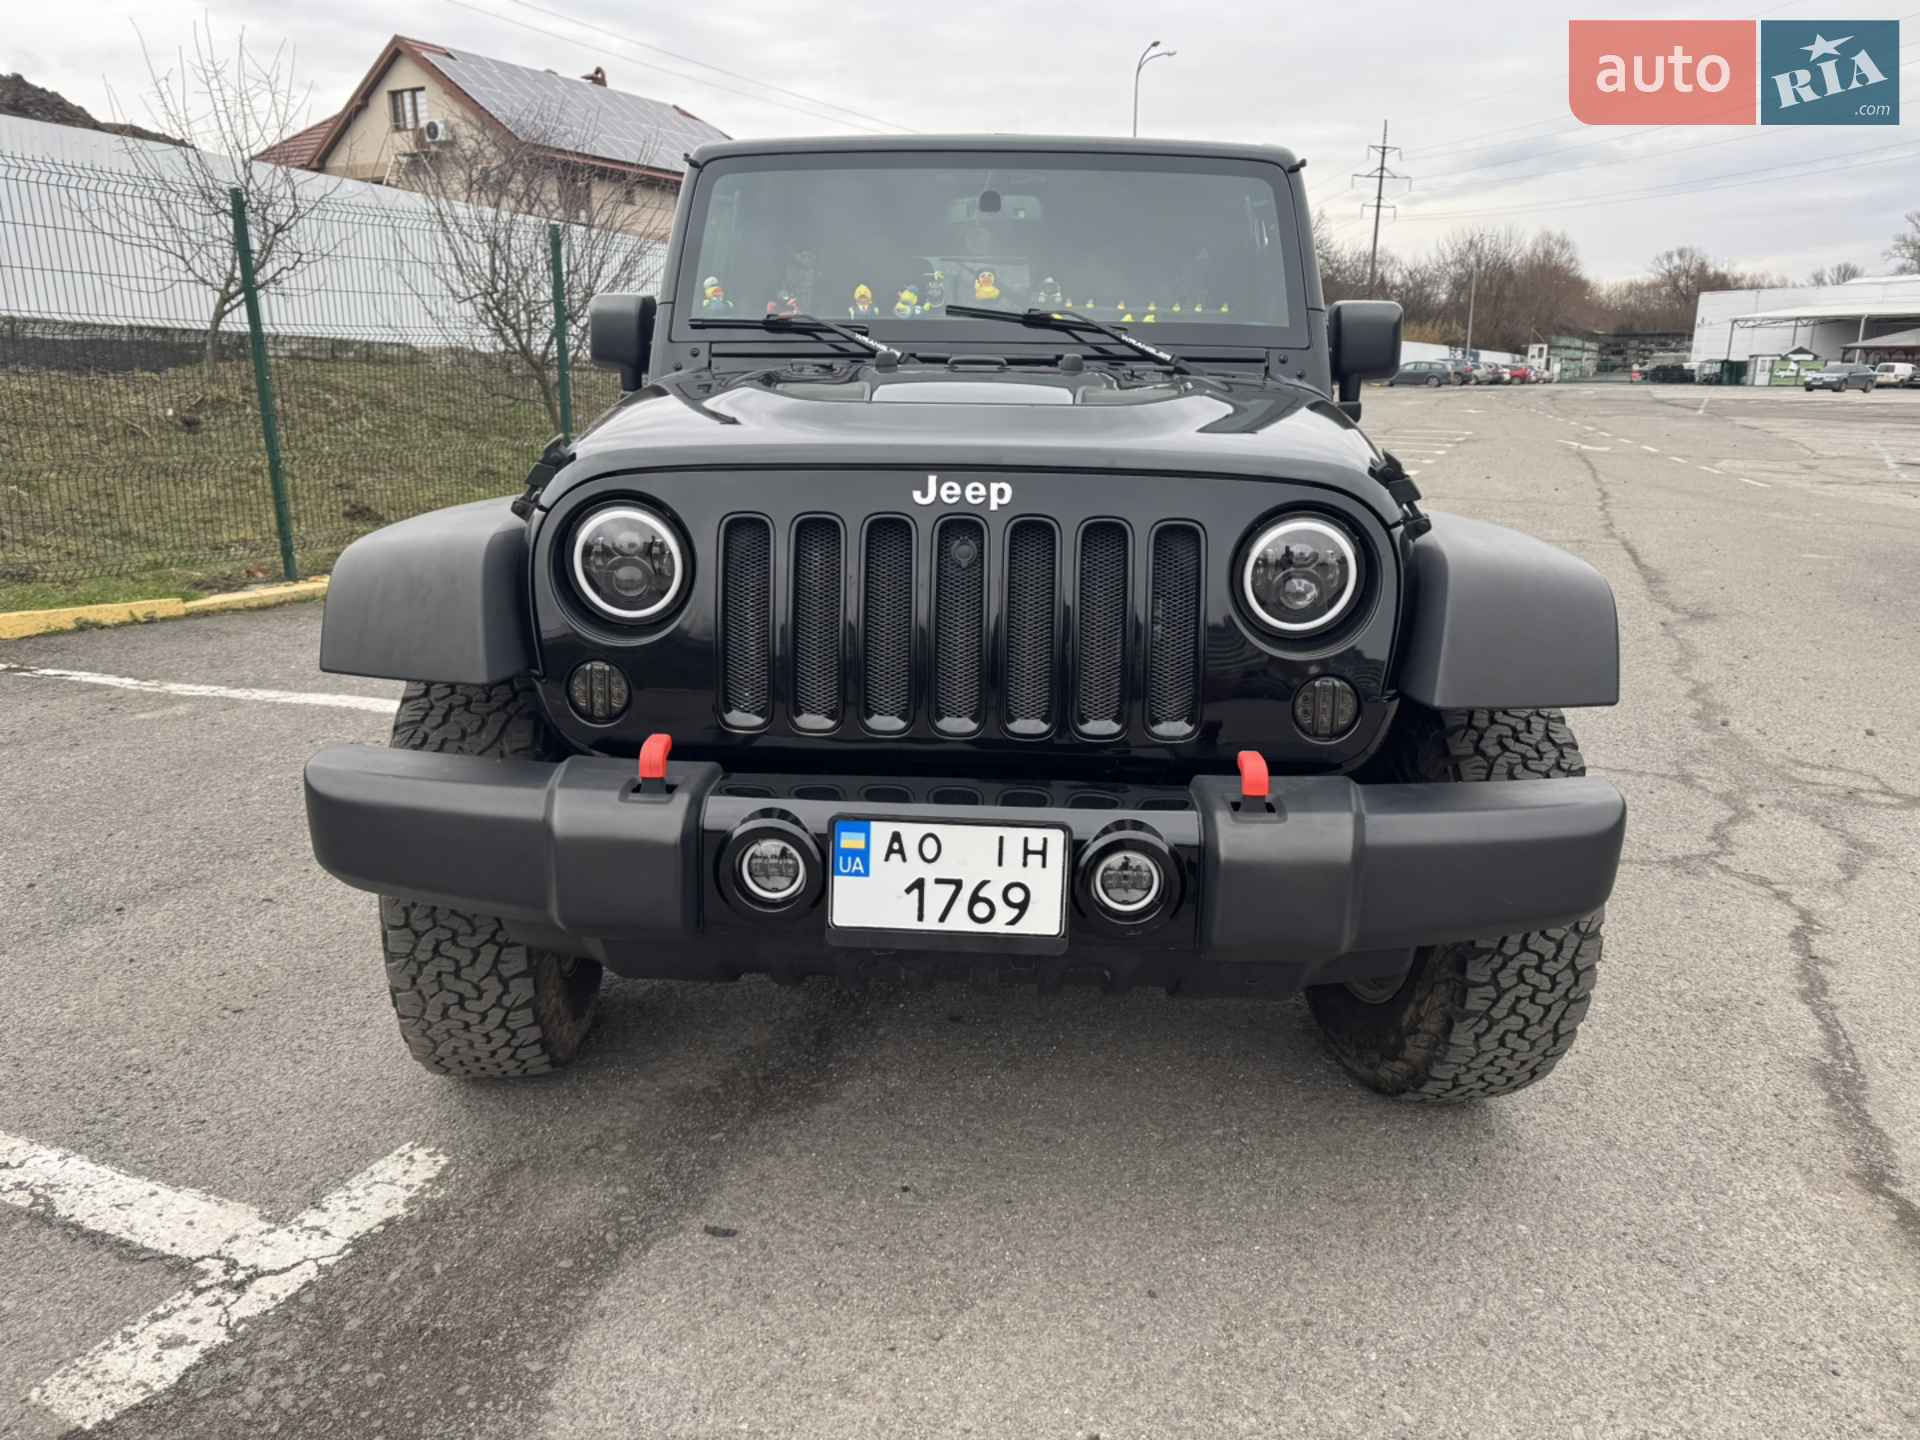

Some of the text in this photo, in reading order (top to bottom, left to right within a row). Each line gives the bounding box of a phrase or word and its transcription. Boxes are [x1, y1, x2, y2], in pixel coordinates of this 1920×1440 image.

[1120, 334, 1172, 362] WRANGLER
[912, 474, 1013, 511] Jeep
[839, 856, 865, 874] UA
[904, 876, 1031, 926] 1769
